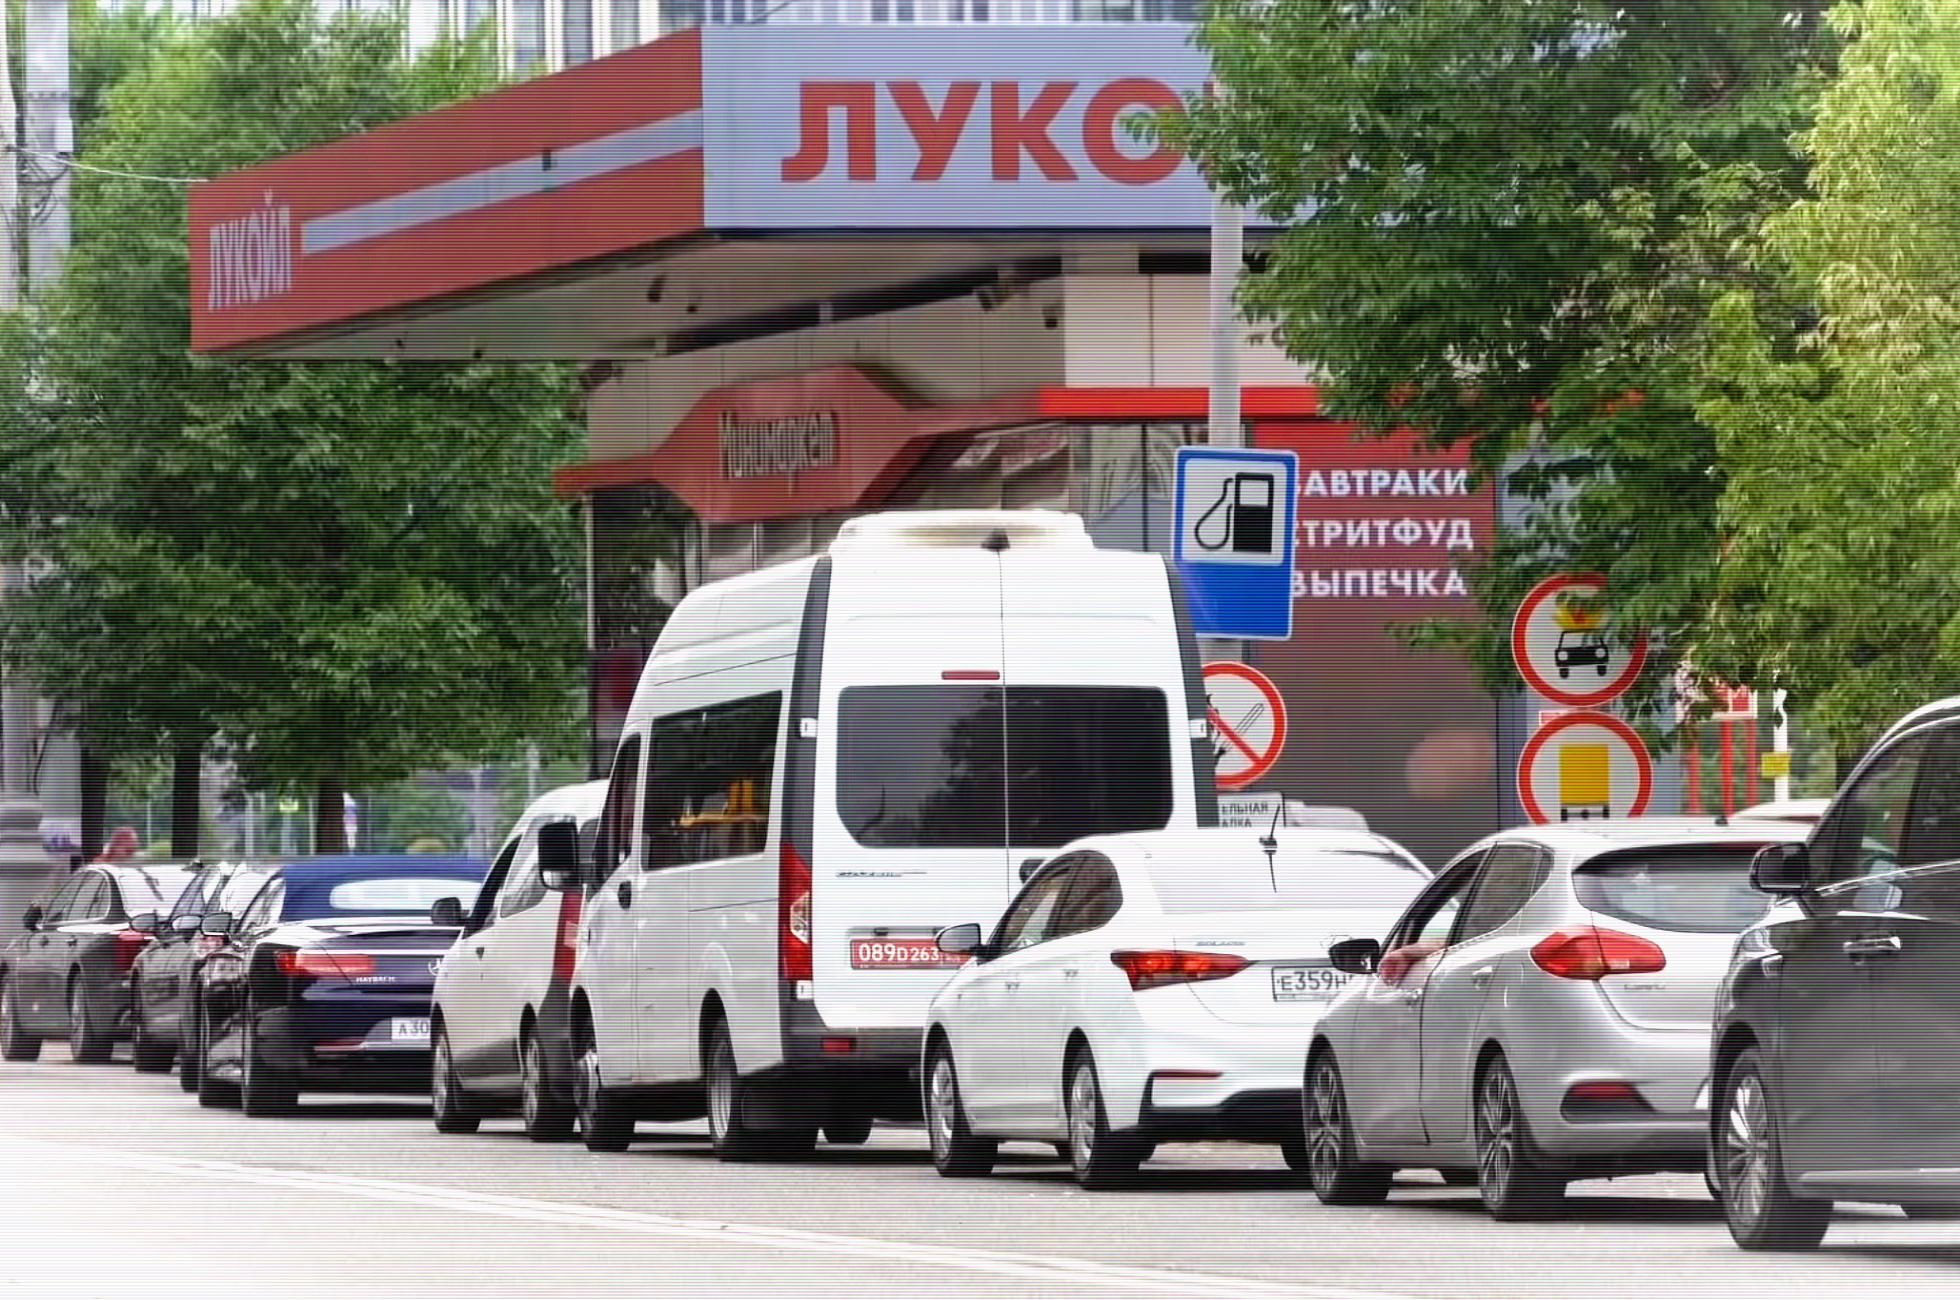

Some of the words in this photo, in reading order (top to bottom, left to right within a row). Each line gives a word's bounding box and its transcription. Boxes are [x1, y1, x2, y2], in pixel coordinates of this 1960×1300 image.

[780, 77, 1214, 186] ЛУКО
[207, 186, 292, 313] ЛУКОЙЛ
[1296, 468, 1470, 498] АВТРАКИ
[1294, 517, 1475, 551] ТРИТФУД
